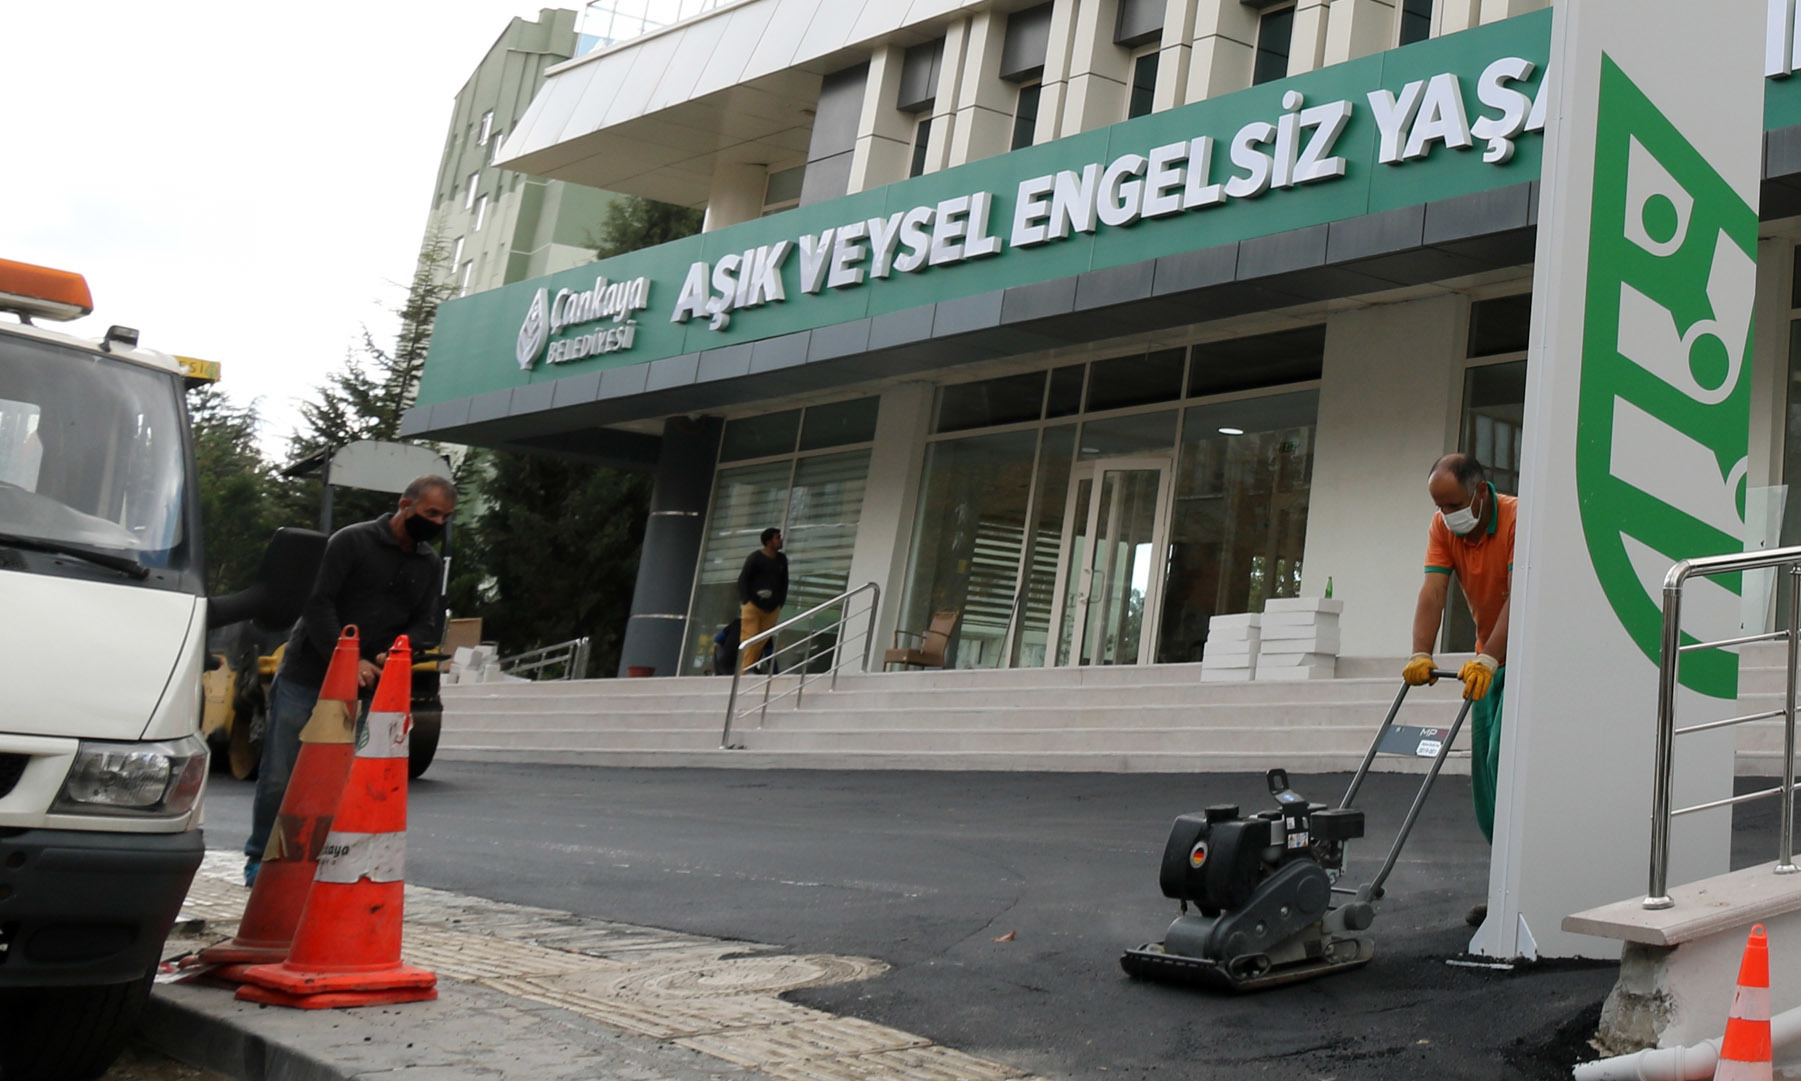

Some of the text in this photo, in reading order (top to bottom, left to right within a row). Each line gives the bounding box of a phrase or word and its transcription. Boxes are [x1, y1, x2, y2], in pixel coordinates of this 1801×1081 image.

[670, 240, 794, 332] AŞIK
[799, 191, 1002, 294] VEYSEL
[1009, 90, 1352, 248] ENGELSİZ
[1366, 56, 1551, 164] YAŞ
[549, 276, 651, 335] Çankaya
[546, 319, 637, 364] BELEDİYESİ
